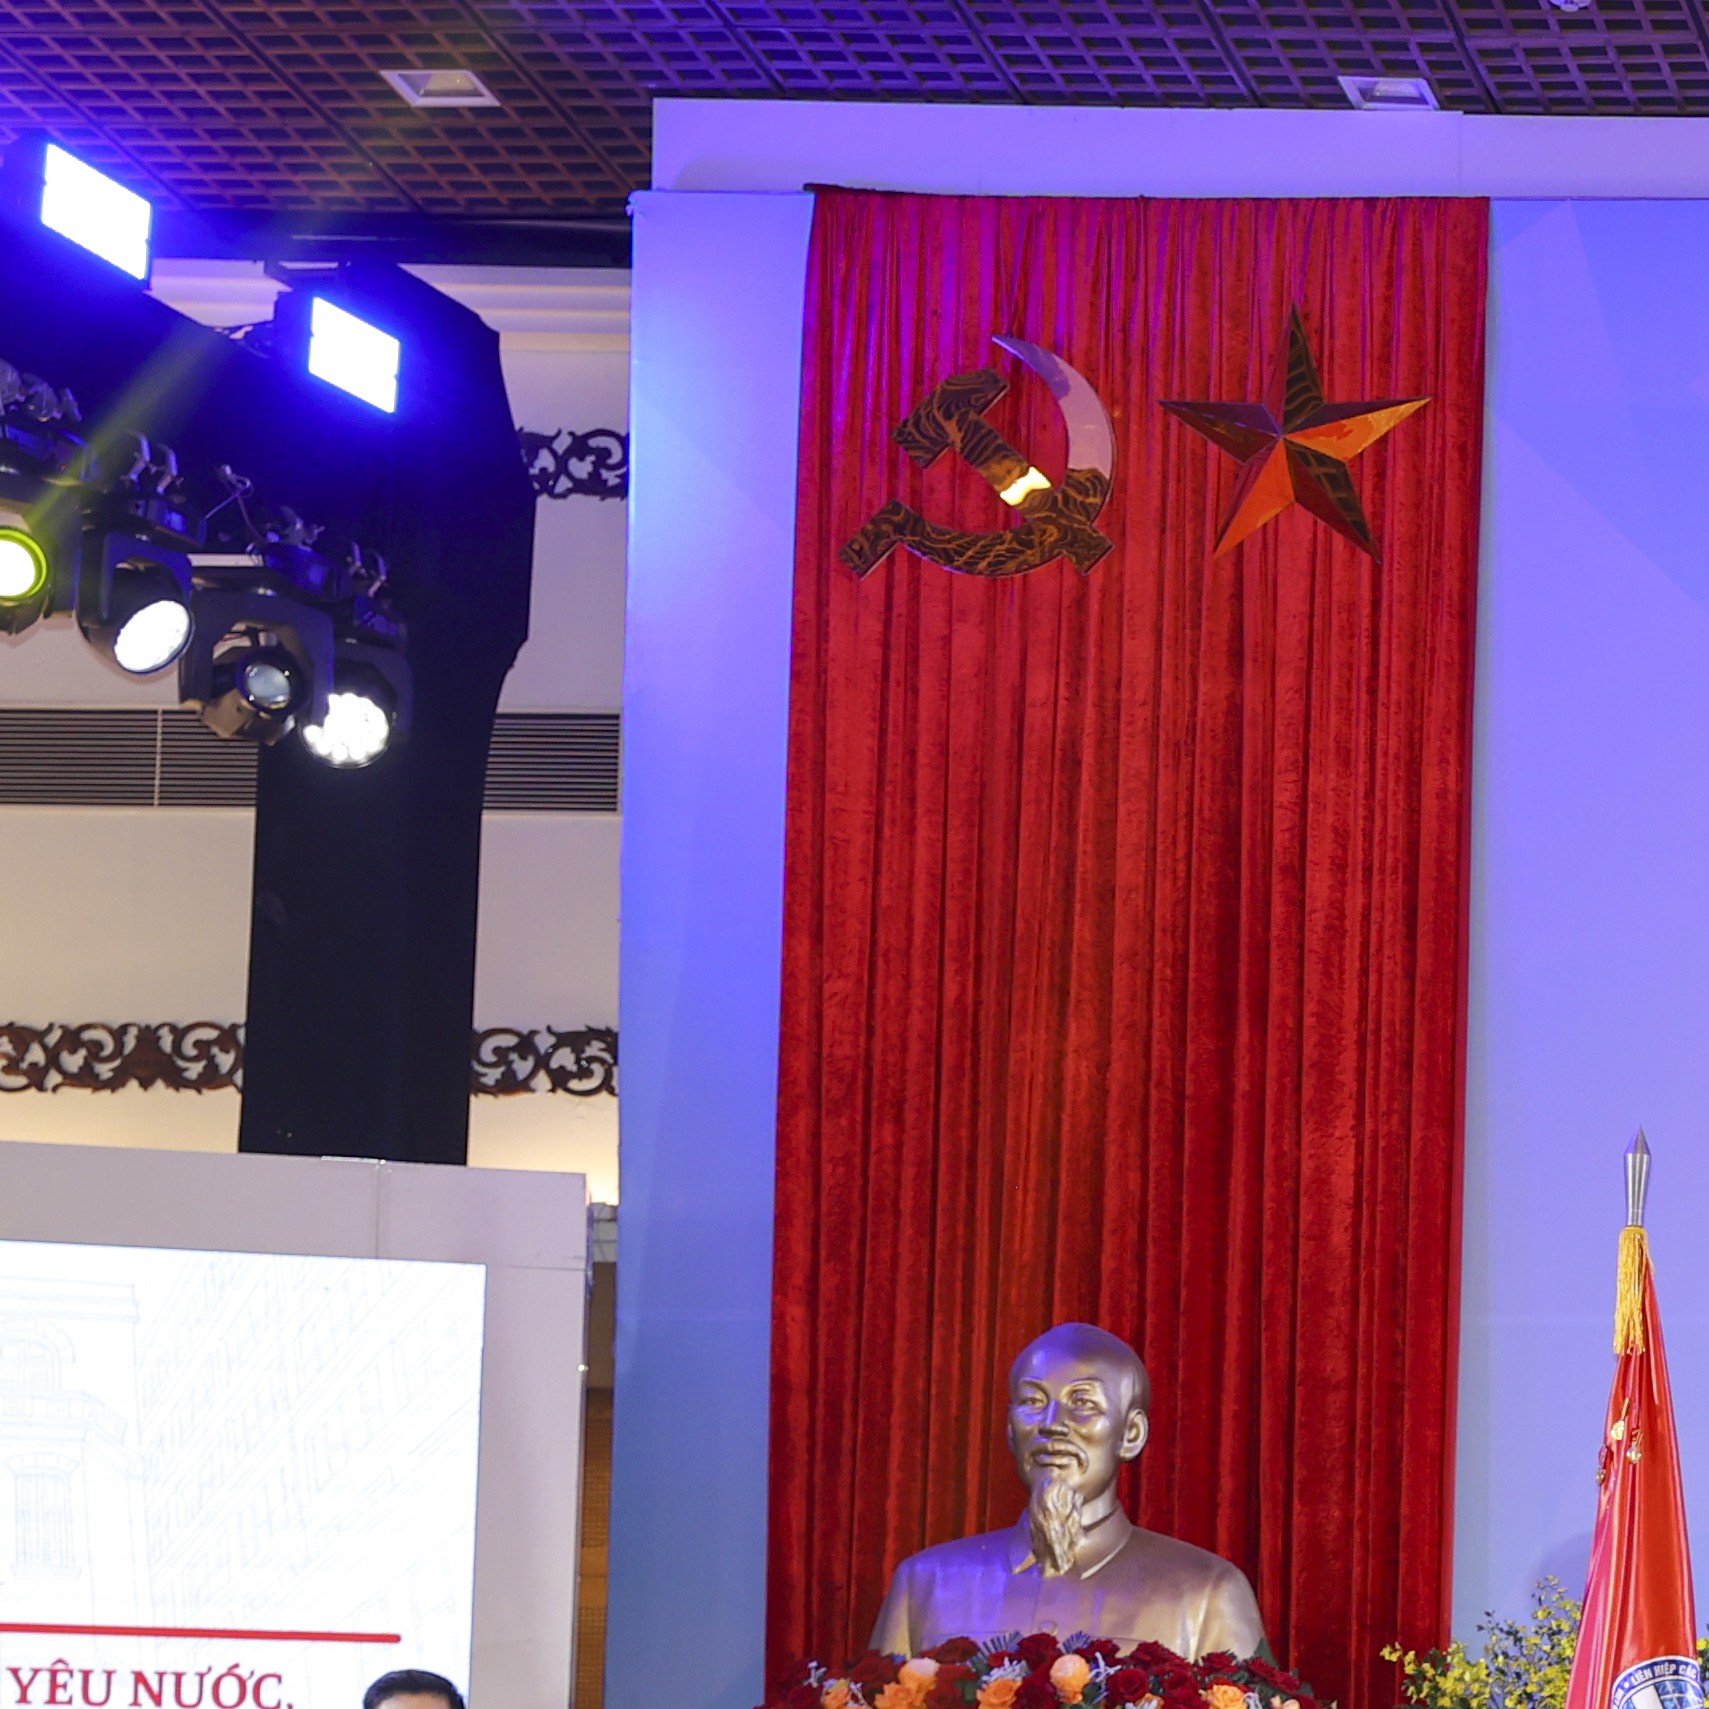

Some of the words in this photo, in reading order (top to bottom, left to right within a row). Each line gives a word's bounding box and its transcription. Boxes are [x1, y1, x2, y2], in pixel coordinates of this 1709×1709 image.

[8, 1659, 116, 1708] YÊU
[1630, 1668, 1653, 1686] LIÊN
[1654, 1663, 1677, 1676] HIỆP
[1678, 1663, 1698, 1679] CÁC
